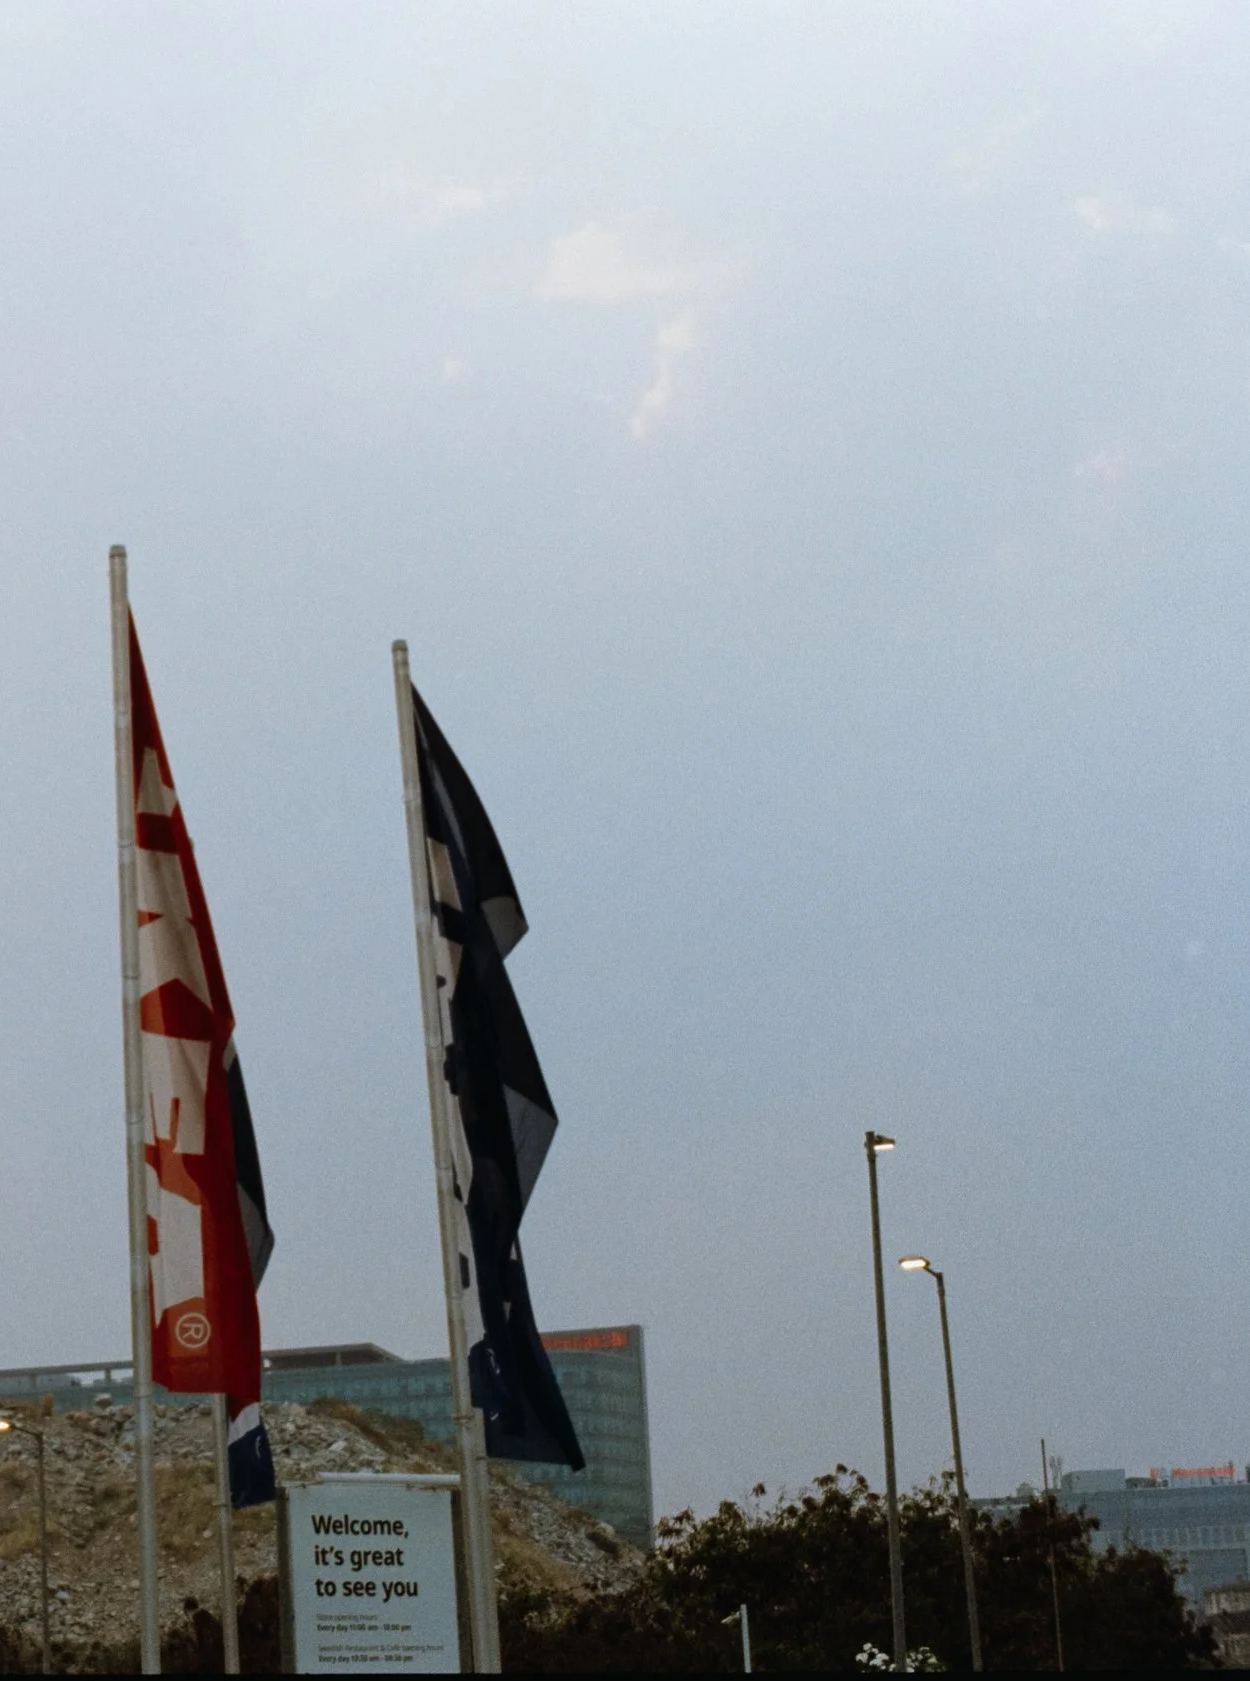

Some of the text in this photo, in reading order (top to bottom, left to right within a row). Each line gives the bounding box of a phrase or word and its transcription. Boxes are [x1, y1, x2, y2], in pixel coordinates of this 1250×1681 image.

[311, 1514, 409, 1539] Welcome,
[314, 1545, 404, 1572] it’s great
[315, 1578, 418, 1603] to see you
[317, 1623, 335, 1632] Every
[336, 1623, 348, 1632] day
[318, 1655, 336, 1664] Every
[337, 1655, 350, 1664] day
